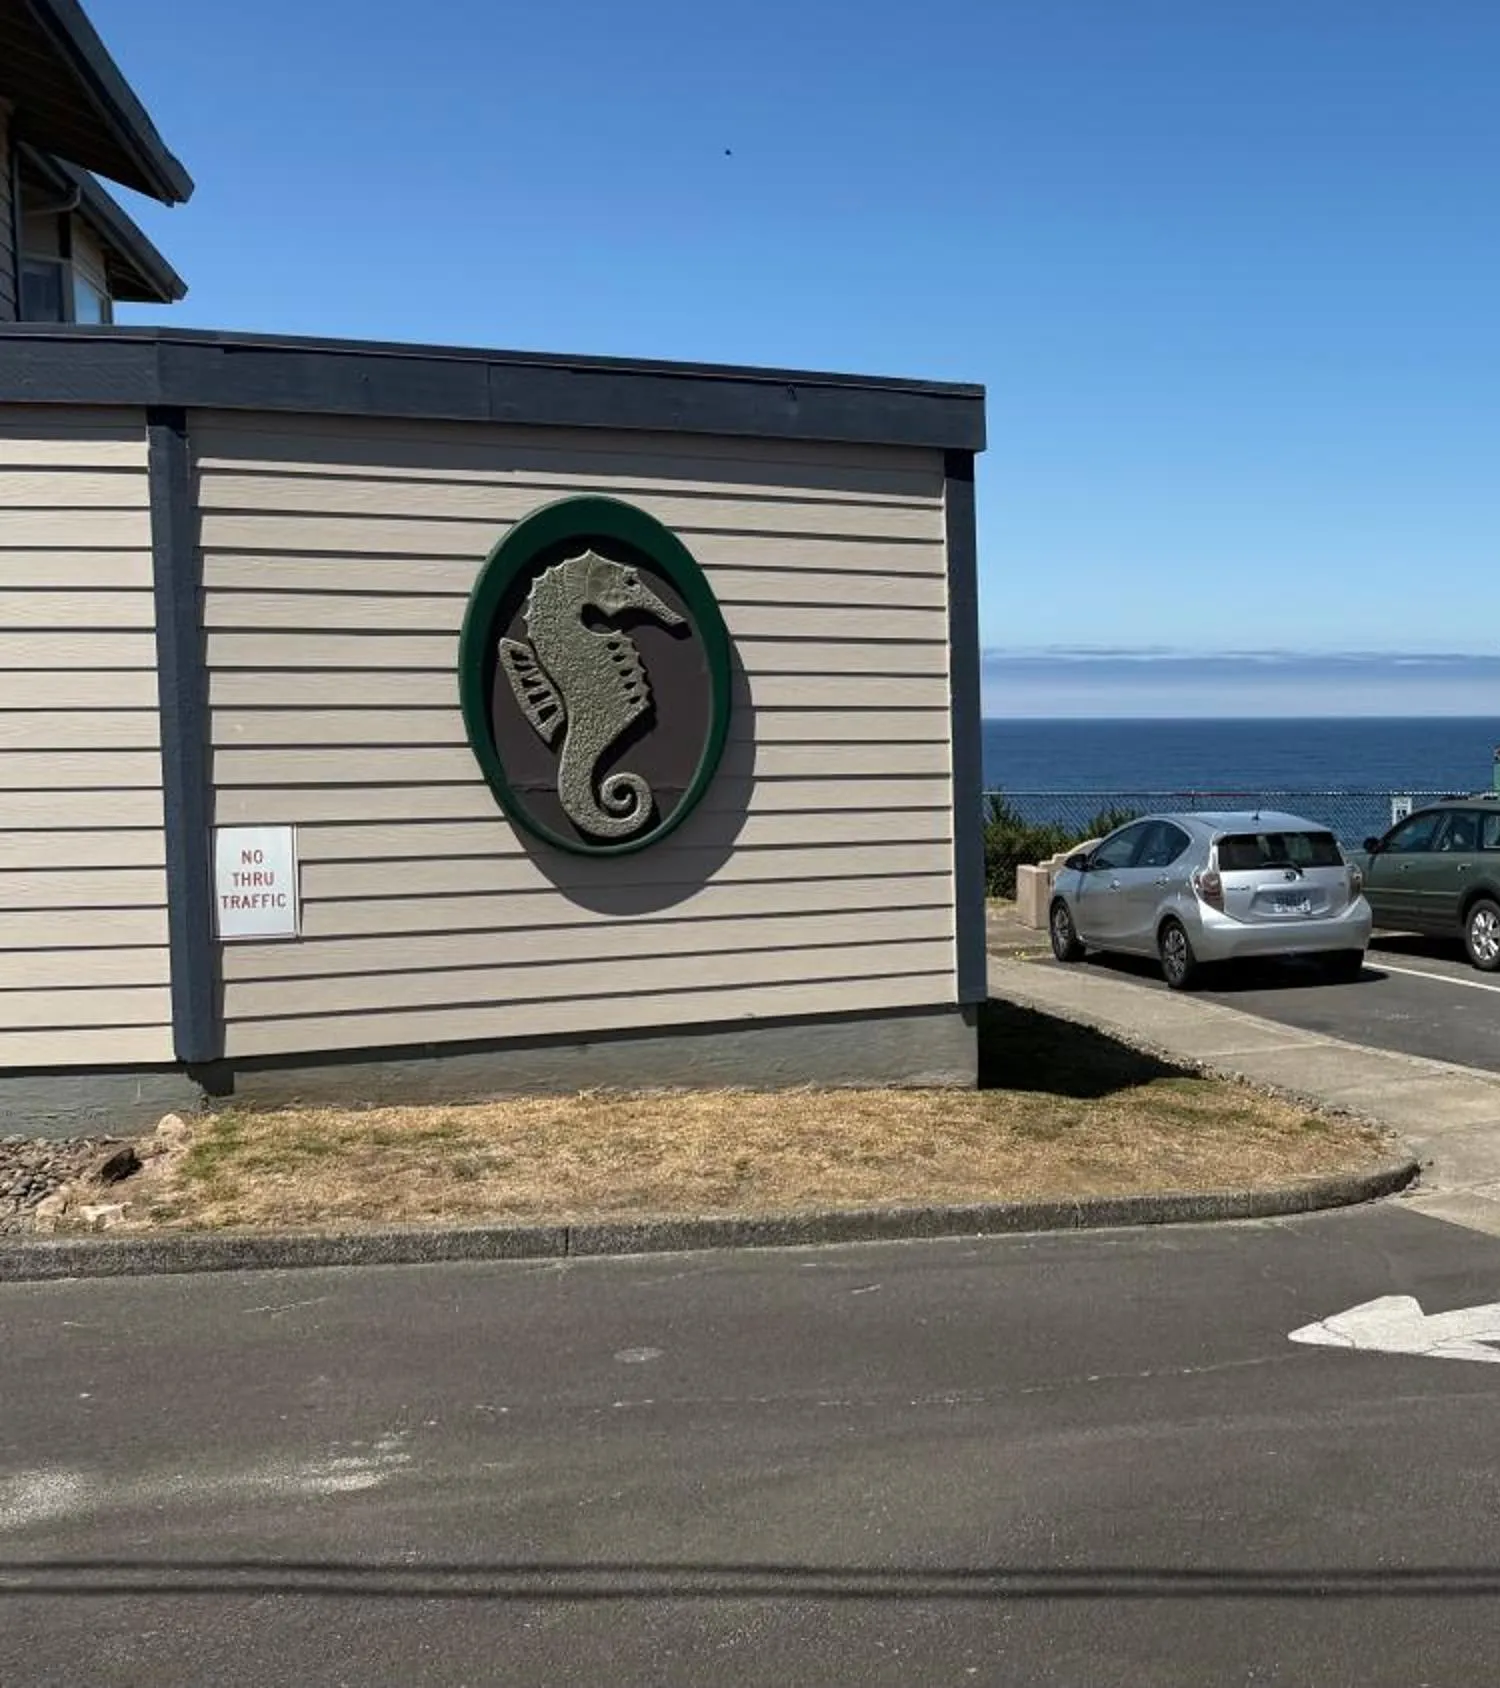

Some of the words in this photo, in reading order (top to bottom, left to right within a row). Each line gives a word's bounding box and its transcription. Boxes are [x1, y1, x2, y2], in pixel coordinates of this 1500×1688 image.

[241, 849, 263, 865] NO
[232, 871, 275, 887] THRU
[220, 893, 287, 909] TRAFFIC
